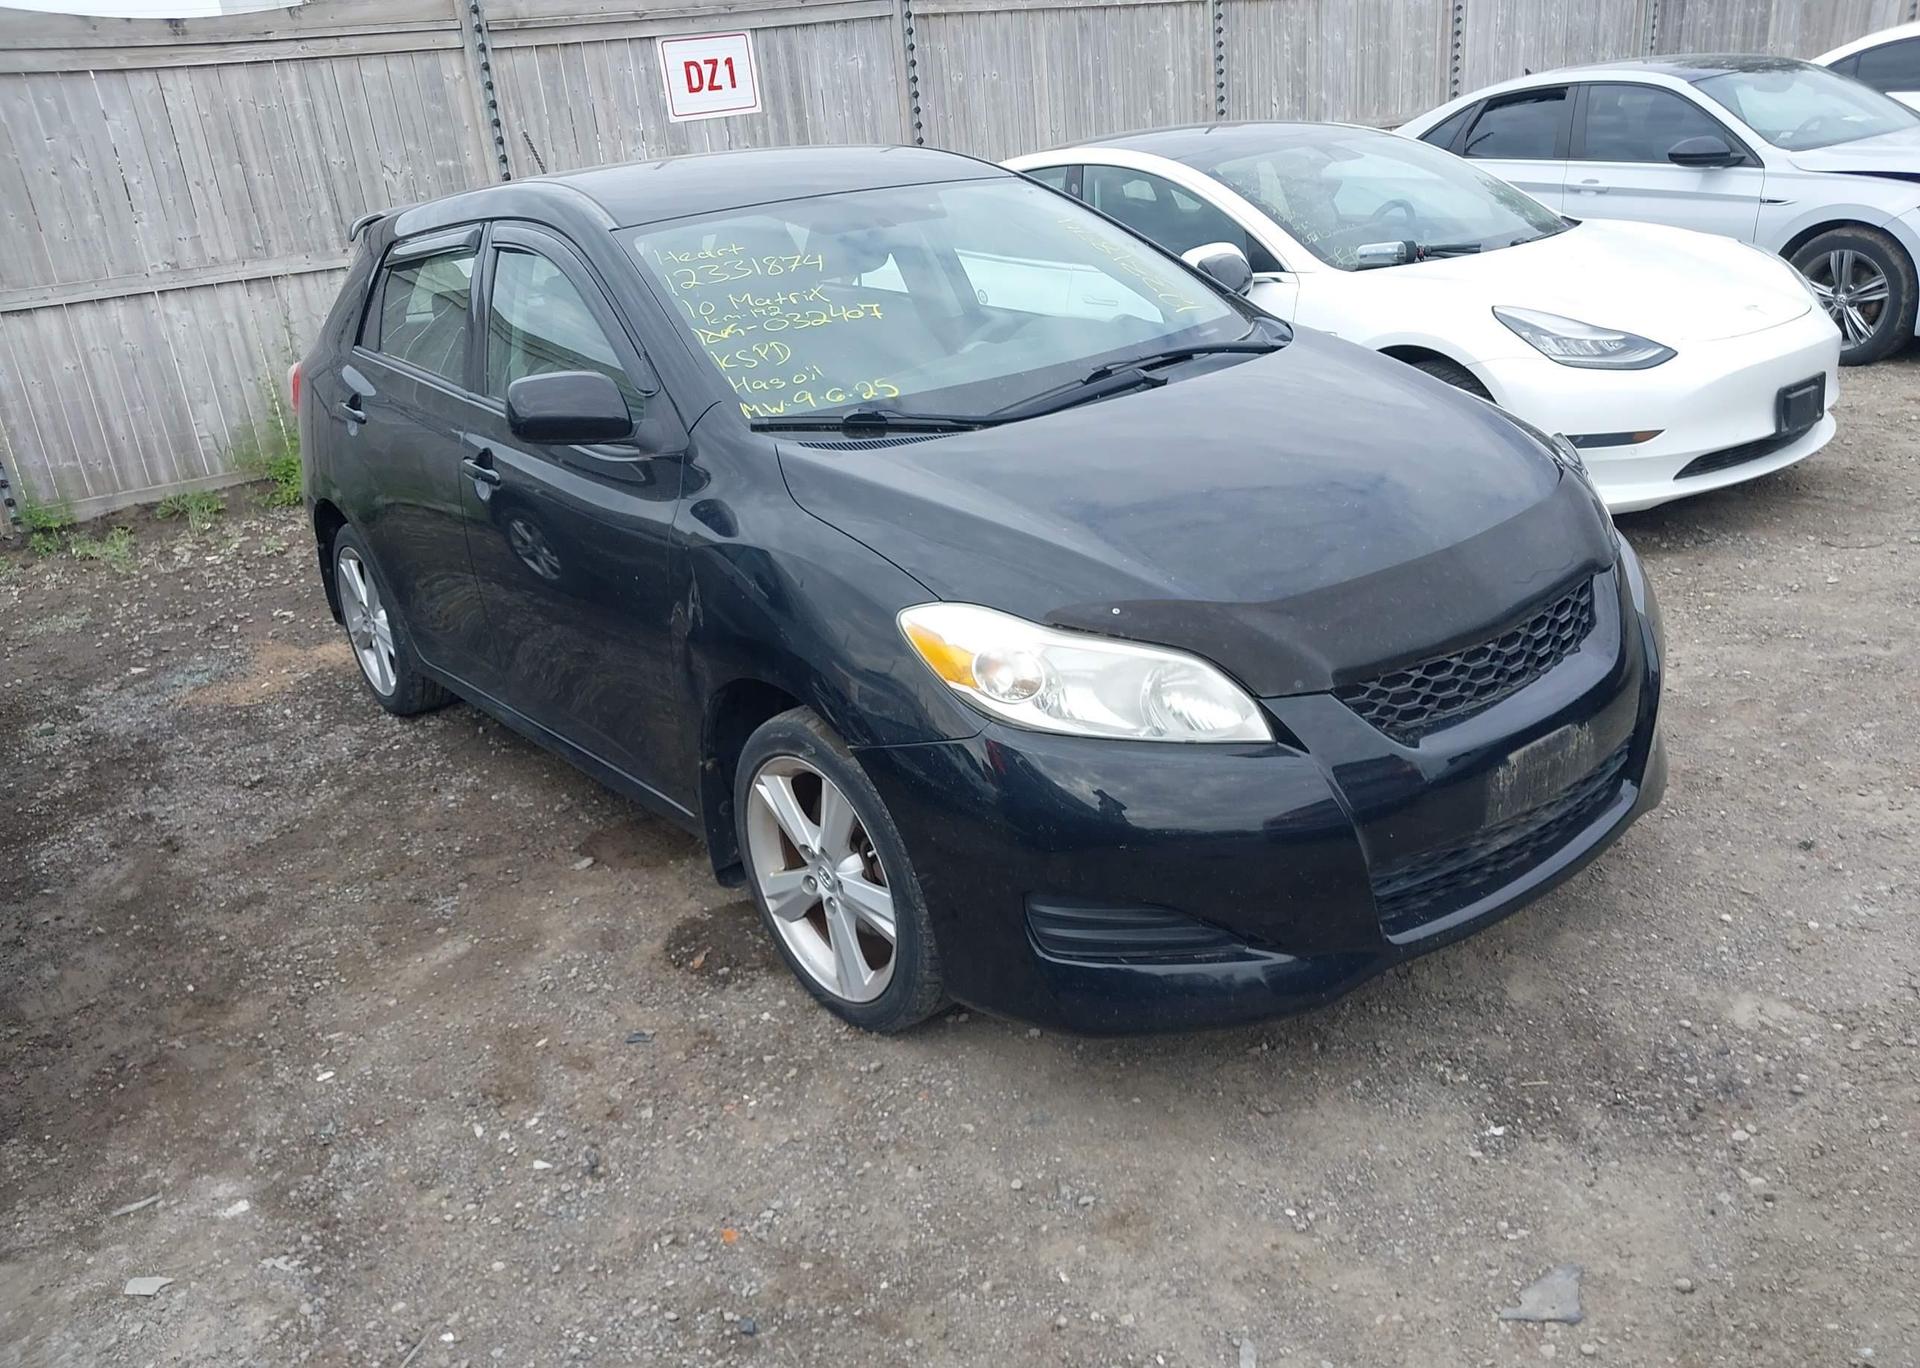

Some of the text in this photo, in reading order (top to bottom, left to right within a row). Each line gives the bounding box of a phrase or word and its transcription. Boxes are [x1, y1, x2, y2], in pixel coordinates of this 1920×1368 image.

[683, 57, 737, 93] DZ1
[654, 243, 745, 265] Heart
[663, 254, 824, 296] 12331874
[683, 299, 715, 319] 10
